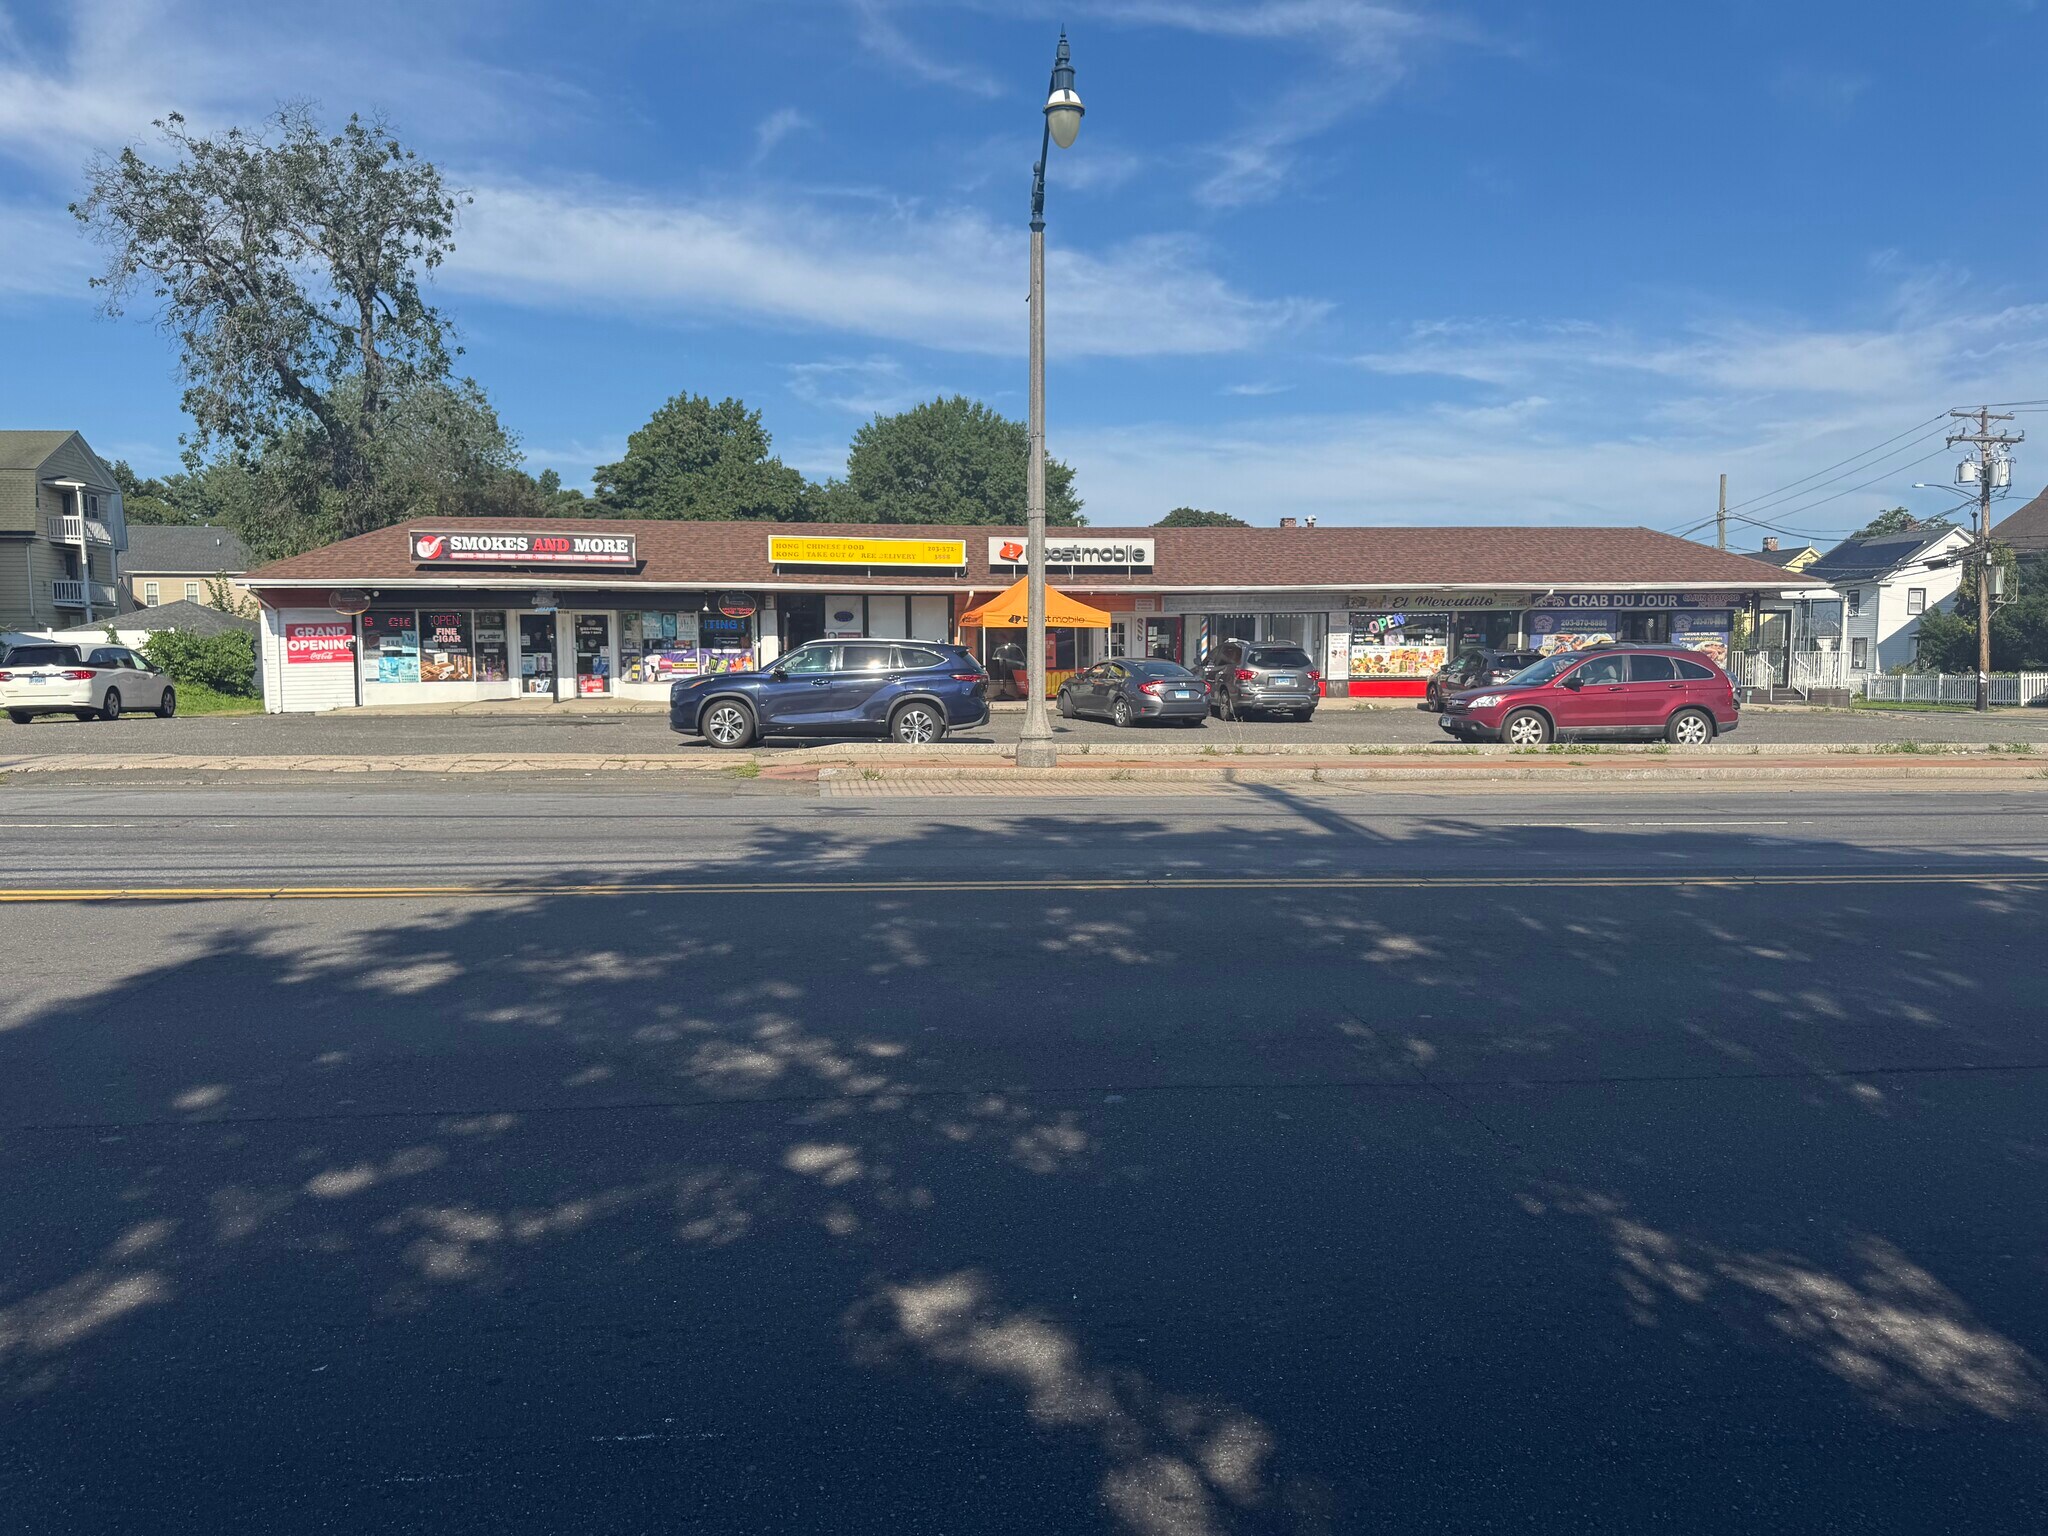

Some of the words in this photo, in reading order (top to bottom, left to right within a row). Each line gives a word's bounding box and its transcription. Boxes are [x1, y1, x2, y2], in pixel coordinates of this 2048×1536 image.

[451, 536, 528, 551] SMOKES
[532, 538, 569, 552] AND
[574, 539, 628, 553] MORE
[1392, 597, 1408, 608] El
[1569, 594, 1609, 607] CRAB
[1613, 595, 1635, 607] DU
[1639, 594, 1678, 608] JOUR
[433, 615, 460, 626] OPEN
[1368, 613, 1405, 634] OPEN
[294, 626, 347, 637] GRAND
[436, 627, 458, 636] FINE
[432, 635, 461, 643] CIGAR
